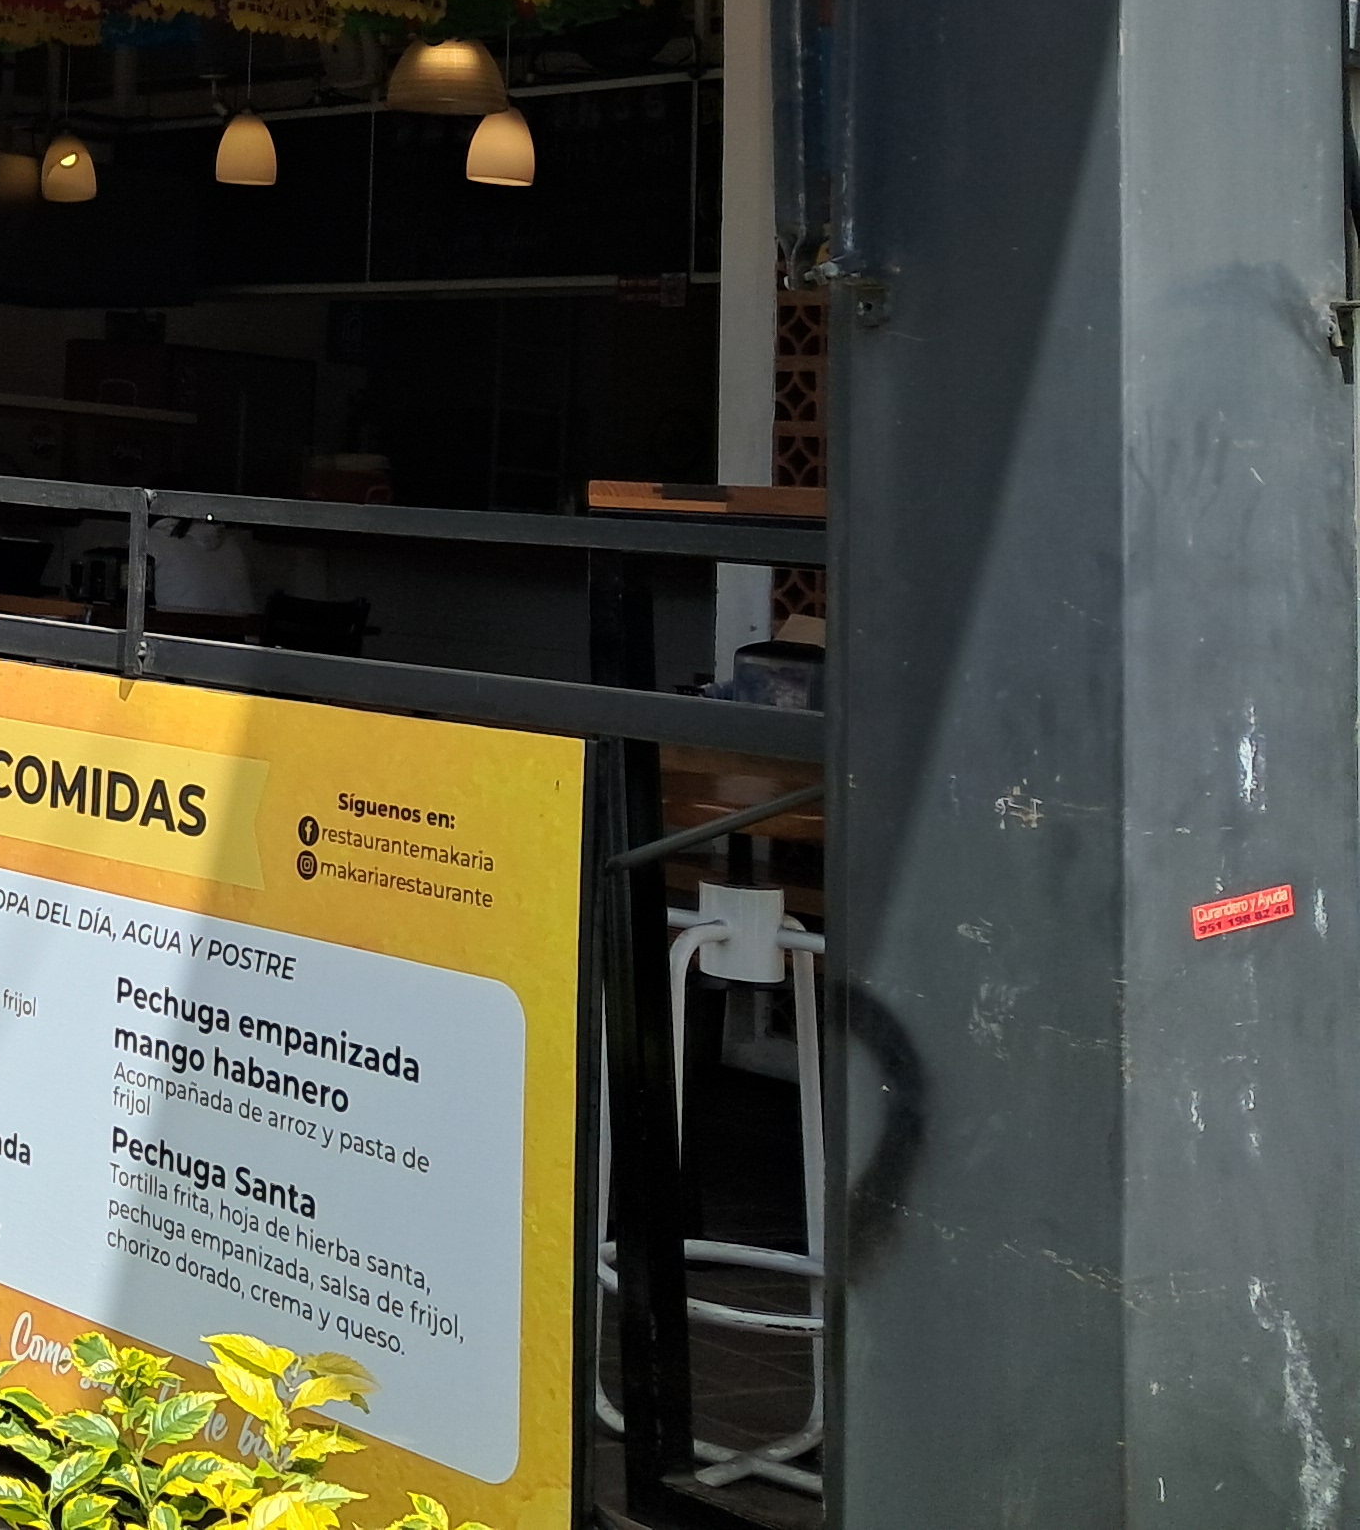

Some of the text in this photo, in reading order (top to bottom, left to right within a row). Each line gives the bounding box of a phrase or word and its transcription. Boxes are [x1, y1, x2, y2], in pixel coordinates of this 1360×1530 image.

[321, 825, 494, 873] restaurantemakaria
[320, 858, 494, 908] makariarestaurante
[1250, 899, 1255, 912] y
[1257, 888, 1288, 906] Ayuda
[35, 898, 72, 925] DEL
[75, 904, 118, 941] DÍA,
[122, 921, 182, 955] AGUA
[188, 935, 204, 959] Y
[208, 936, 297, 982] POSTRE
[1198, 922, 1222, 934] 951
[1274, 904, 1289, 915] 48
[3, 989, 37, 1017] frijol
[116, 976, 420, 1083] Pechuga empanizada
[113, 1087, 151, 1116] frijol
[114, 1026, 349, 1113] mango habanero
[114, 1061, 430, 1173] Acompañada de arroz y pasta de
[113, 1126, 317, 1219] Pechuga Santa
[109, 1162, 432, 1294] Tortilla frita, hoja de hierba santa,
